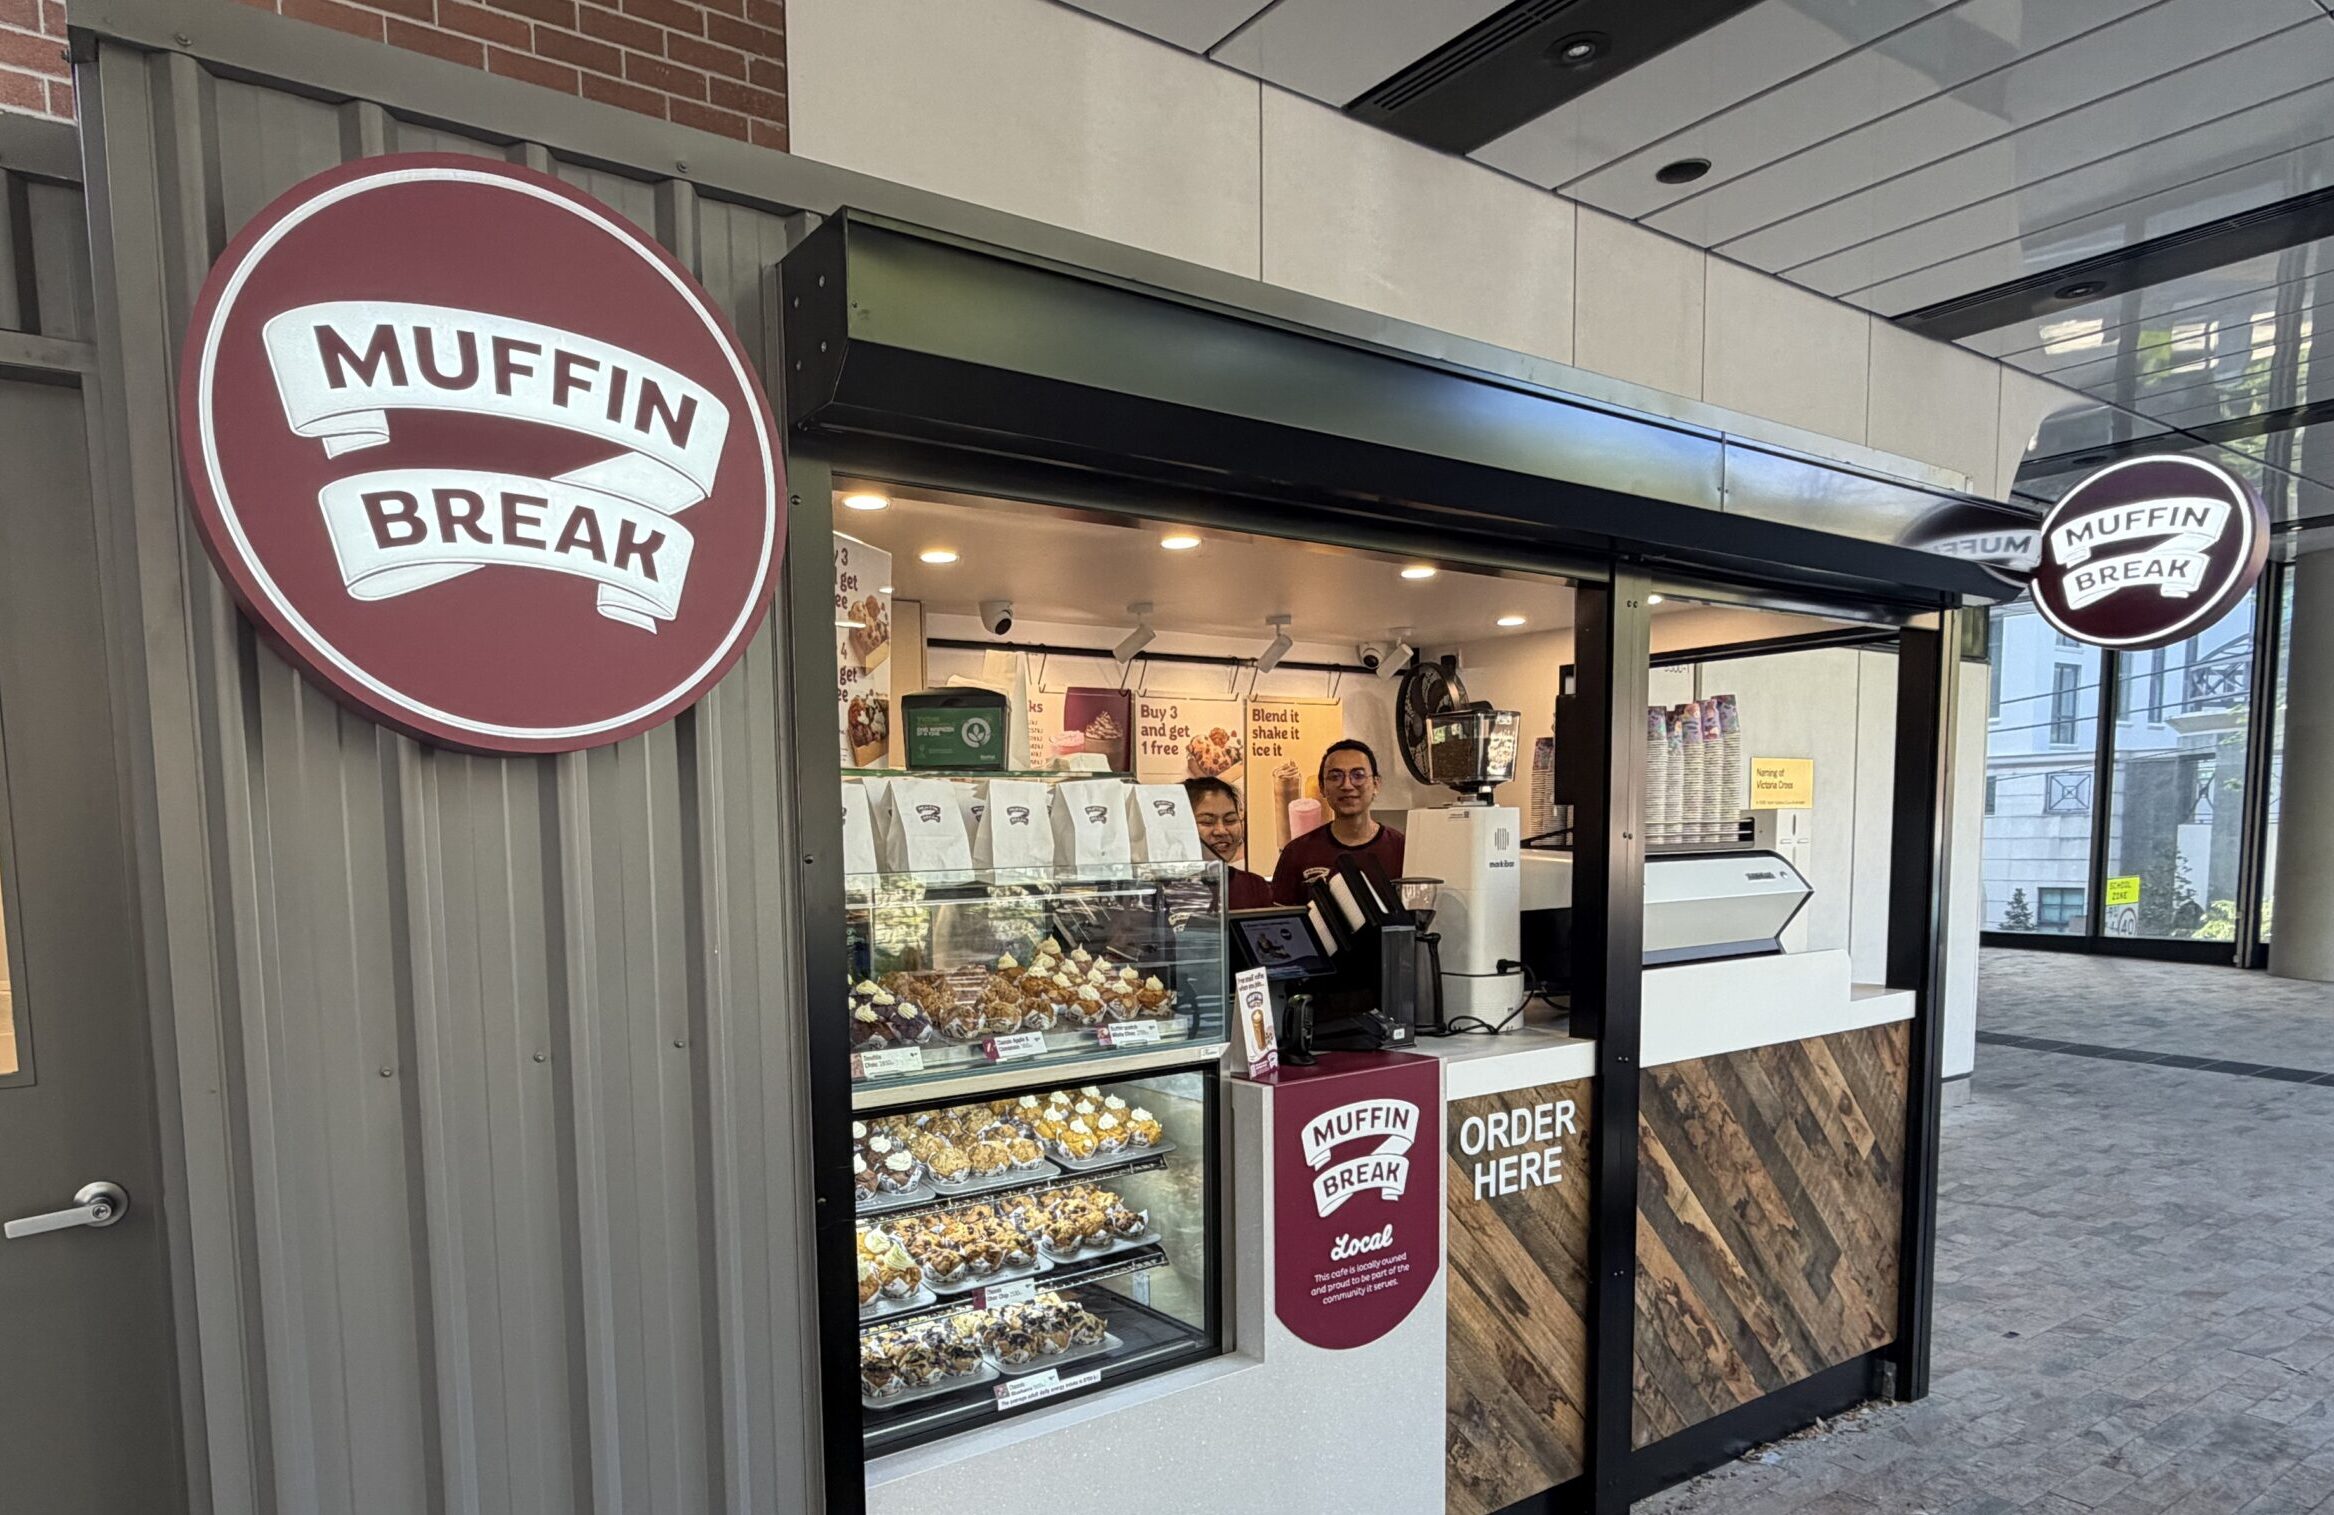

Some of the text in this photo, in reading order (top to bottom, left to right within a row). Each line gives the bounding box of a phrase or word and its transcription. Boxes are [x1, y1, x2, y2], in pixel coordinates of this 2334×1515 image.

[313, 324, 699, 450] MUFFIN
[360, 488, 666, 582] BREAK
[2065, 506, 2212, 548] MUFFIN
[841, 548, 849, 567] 3
[840, 572, 858, 592] get
[2074, 559, 2192, 593] BREAK
[840, 642, 848, 660] 4
[840, 666, 858, 686] get
[1140, 704, 1178, 721] Buy 3
[1252, 708, 1300, 724] Blend it
[1141, 722, 1190, 740] and get
[1252, 726, 1300, 741] shake it
[1141, 741, 1179, 755] 1 free
[1252, 744, 1282, 757] ice it
[1757, 768, 1778, 780] Naming
[1757, 780, 1777, 789] Victoria
[2109, 880, 2132, 890] SCHOOL
[2121, 918, 2134, 935] 40
[1313, 1106, 1410, 1147] MUFFIN
[1460, 1100, 1577, 1156] ORDER
[1323, 1161, 1401, 1198] BREAK
[1474, 1146, 1563, 1201] HERE
[1330, 1223, 1394, 1261] Local
[1314, 1252, 1407, 1283] This cafe is locally owned
[1310, 1263, 1410, 1296] and proud to be part of the
[1322, 1278, 1399, 1305] community it serves.
